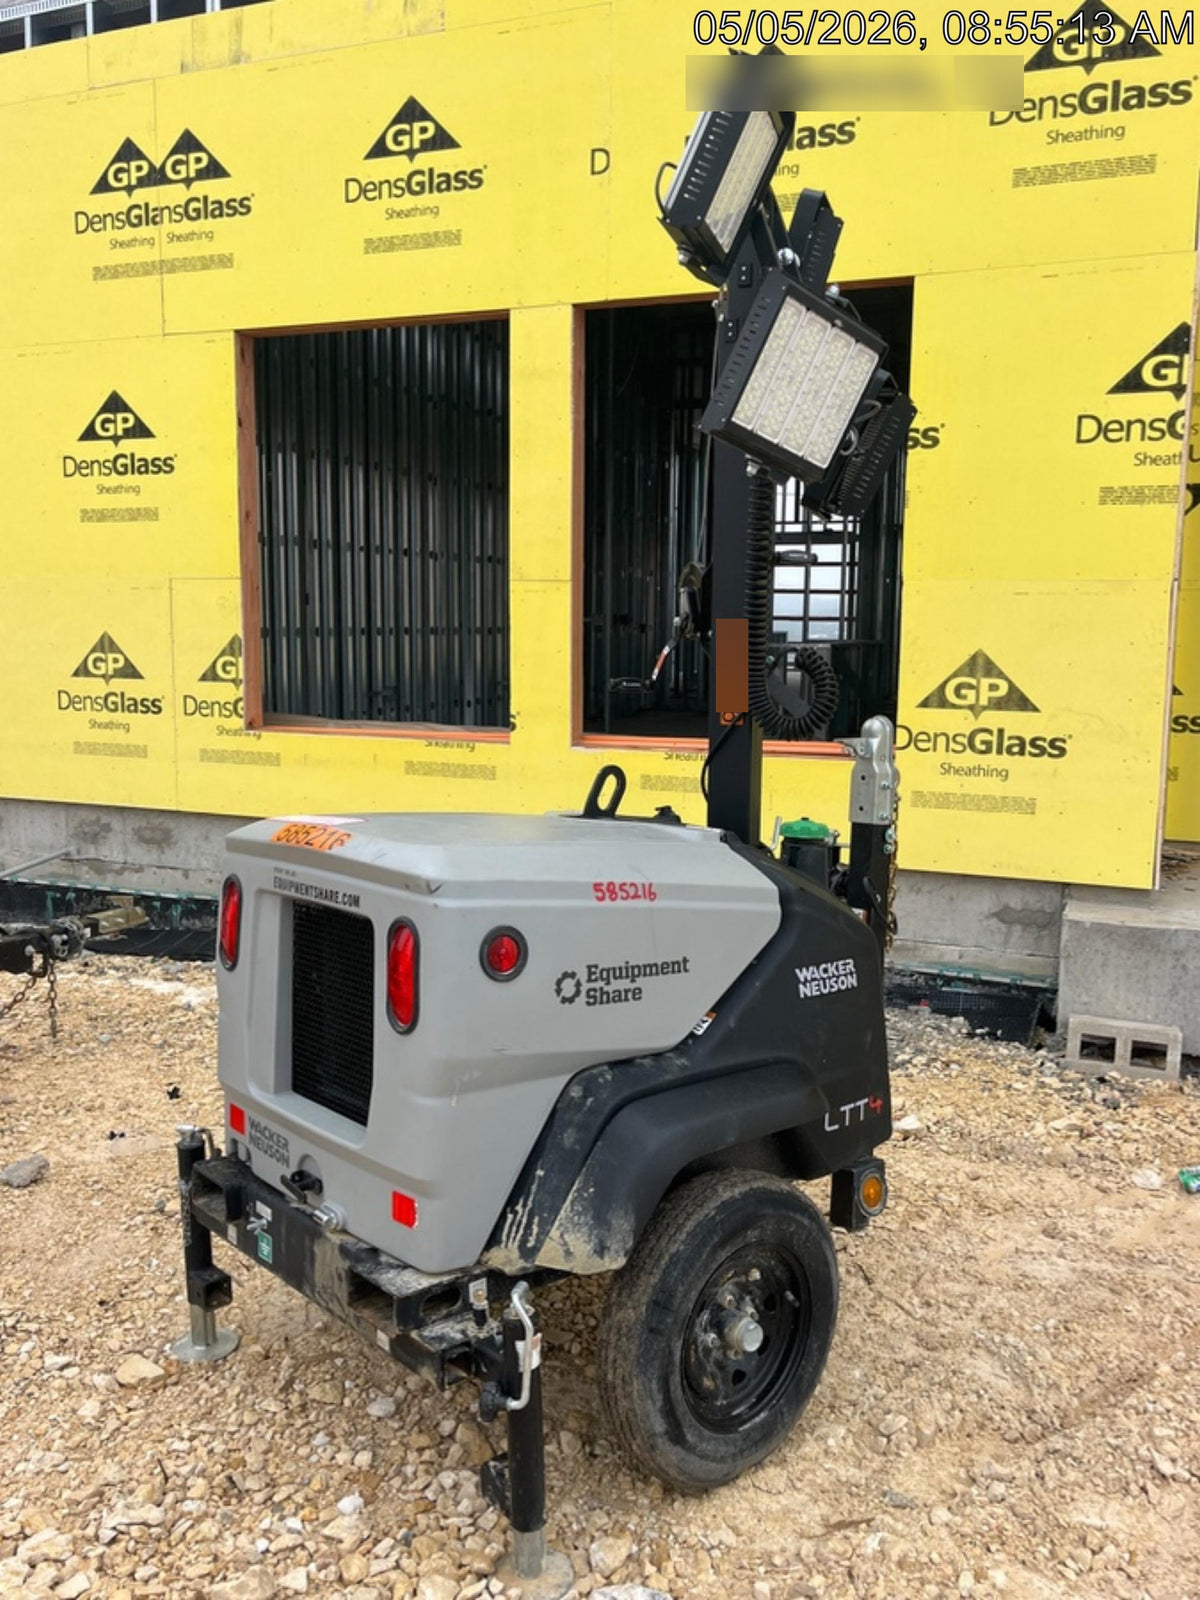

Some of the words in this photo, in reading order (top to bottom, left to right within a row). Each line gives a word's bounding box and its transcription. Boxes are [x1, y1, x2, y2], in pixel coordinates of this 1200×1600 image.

[384, 120, 436, 153] GP
[1046, 125, 1126, 146] Sheathing
[107, 160, 150, 188] GP
[165, 152, 209, 181] GP
[344, 167, 486, 204] DensGlass
[385, 205, 440, 221] Sheathing
[109, 236, 155, 250] Sheathing
[166, 230, 215, 245] Sheathing
[94, 412, 136, 438] GP
[63, 452, 175, 478] DensGlass
[96, 483, 141, 496] Sheathing
[86, 652, 126, 676] GP
[57, 689, 163, 716] DensGlass
[944, 676, 1010, 707] GP
[88, 719, 131, 733] Sheathing
[940, 762, 1009, 782] Sheathing
[592, 881, 658, 903] 585216
[585, 956, 690, 986] Equipment
[794, 958, 856, 982] WACKER
[585, 986, 643, 1006] Share
[798, 973, 858, 998] NEUSON
[824, 1094, 883, 1132] LTT4
[248, 1115, 289, 1152] WACKER
[249, 1131, 290, 1169] NEUSON
